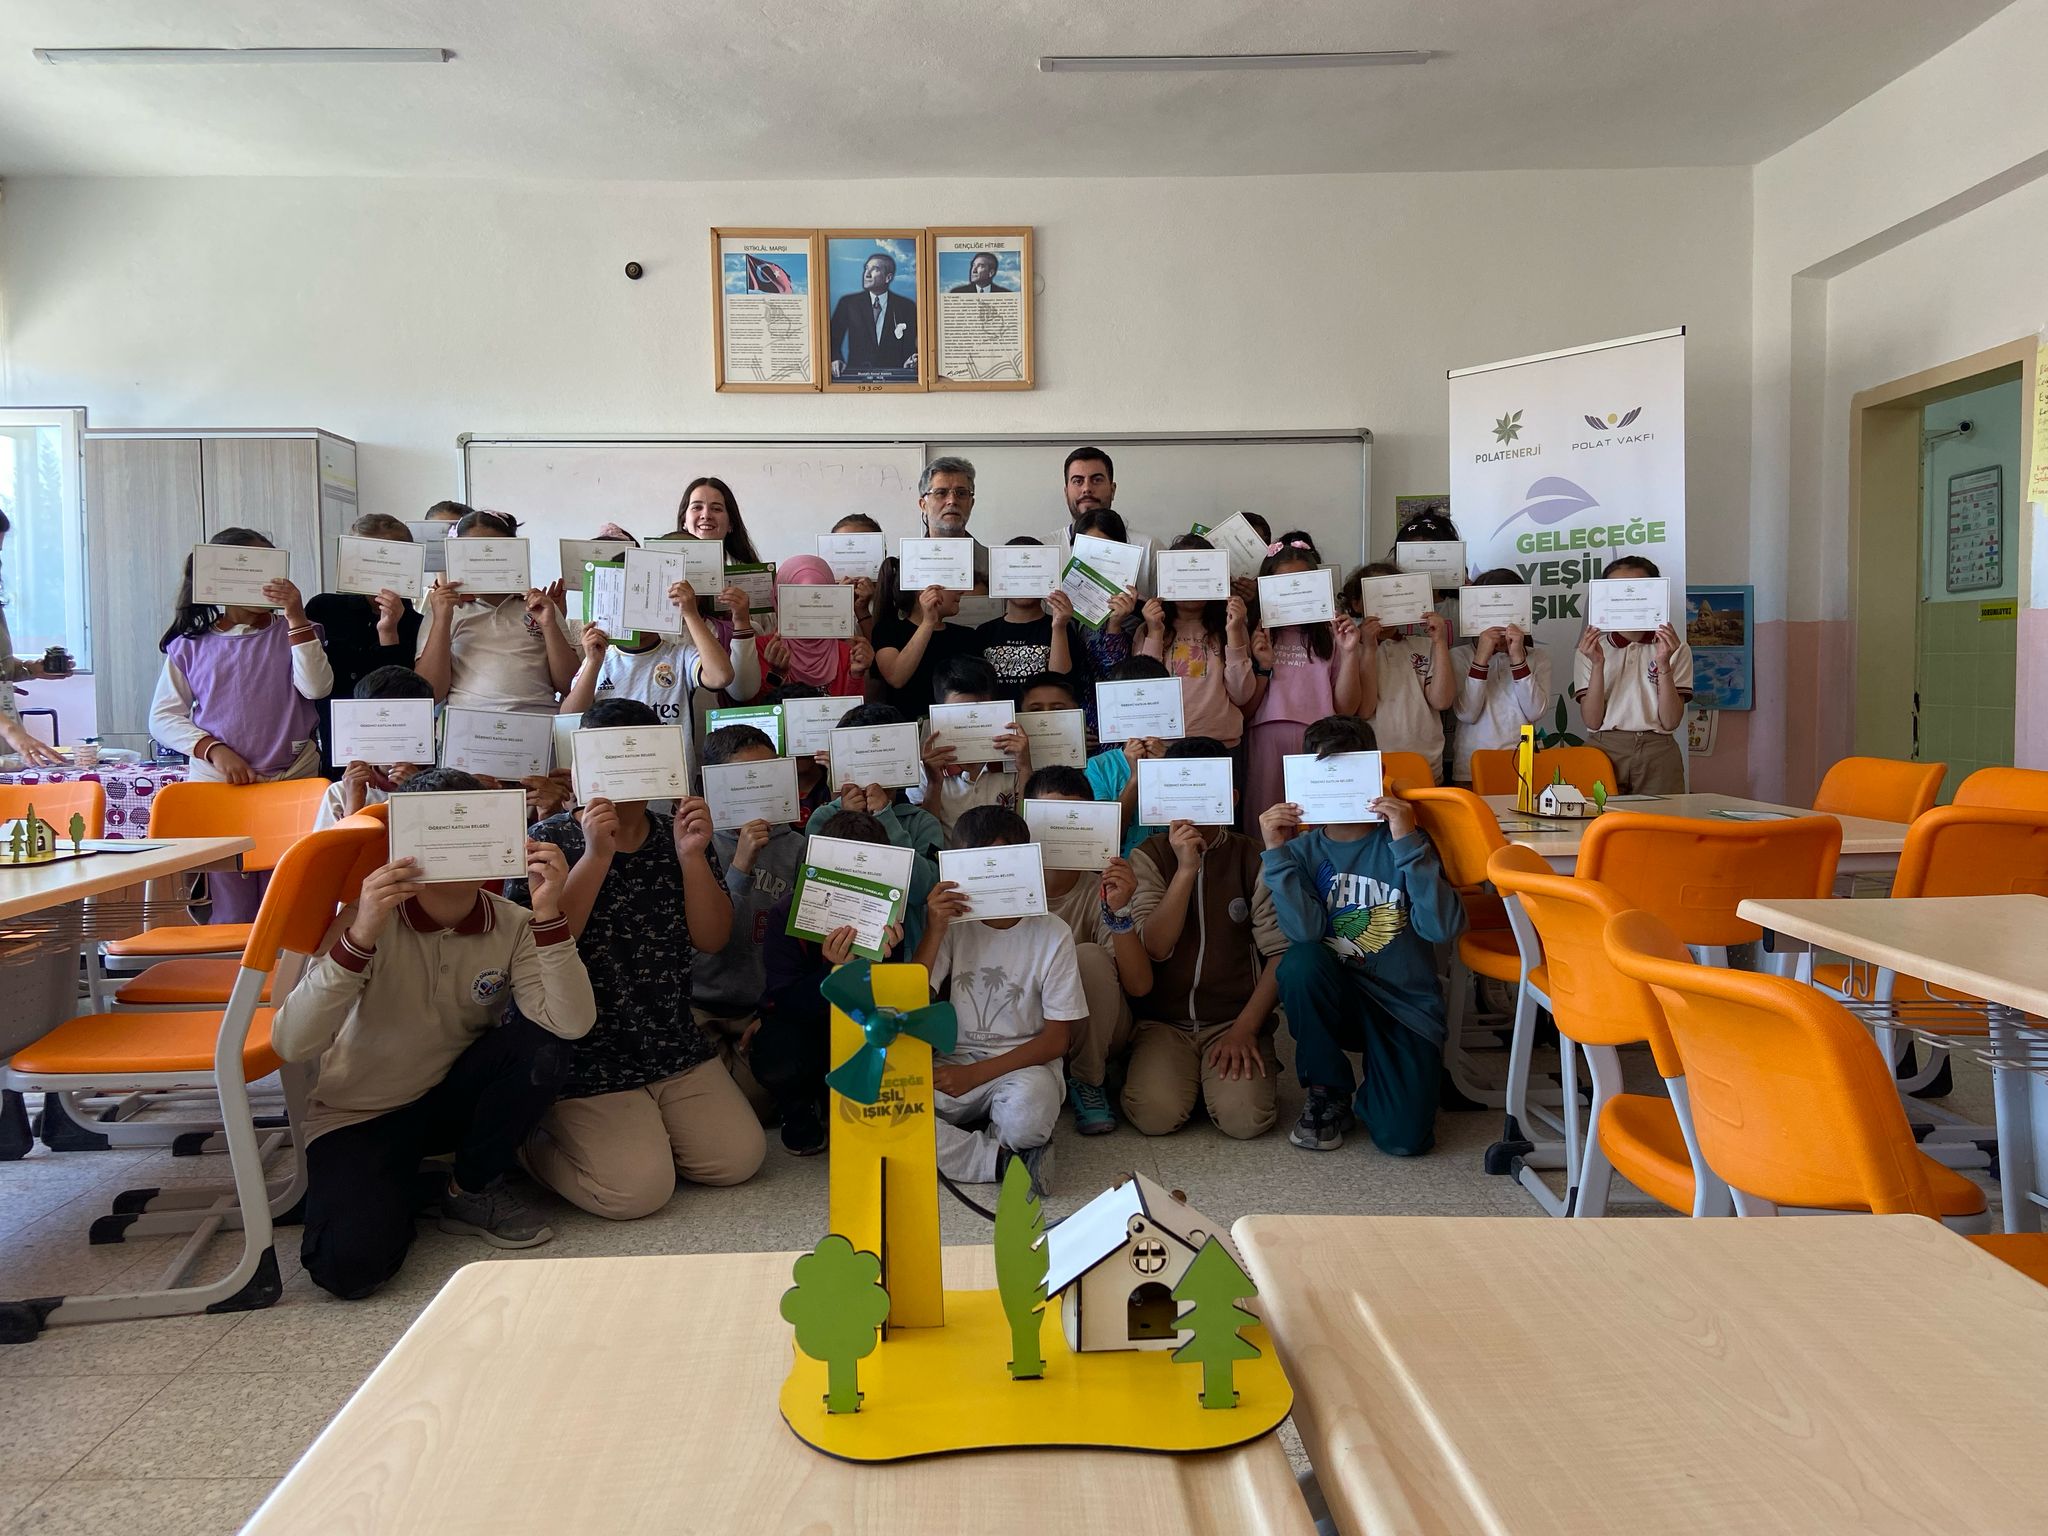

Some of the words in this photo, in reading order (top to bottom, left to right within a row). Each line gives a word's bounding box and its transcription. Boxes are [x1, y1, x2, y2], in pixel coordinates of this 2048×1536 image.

[1571, 438, 1612, 451] POLAT
[1616, 432, 1655, 445] VAKFI
[1475, 443, 1541, 464] POLATENERJİ
[1516, 517, 1666, 554] GELECEĞE
[1532, 594, 1582, 625] ŞIK
[651, 701, 680, 719] tes
[863, 1105, 891, 1119] IŞIK
[894, 1102, 925, 1115] YAK
